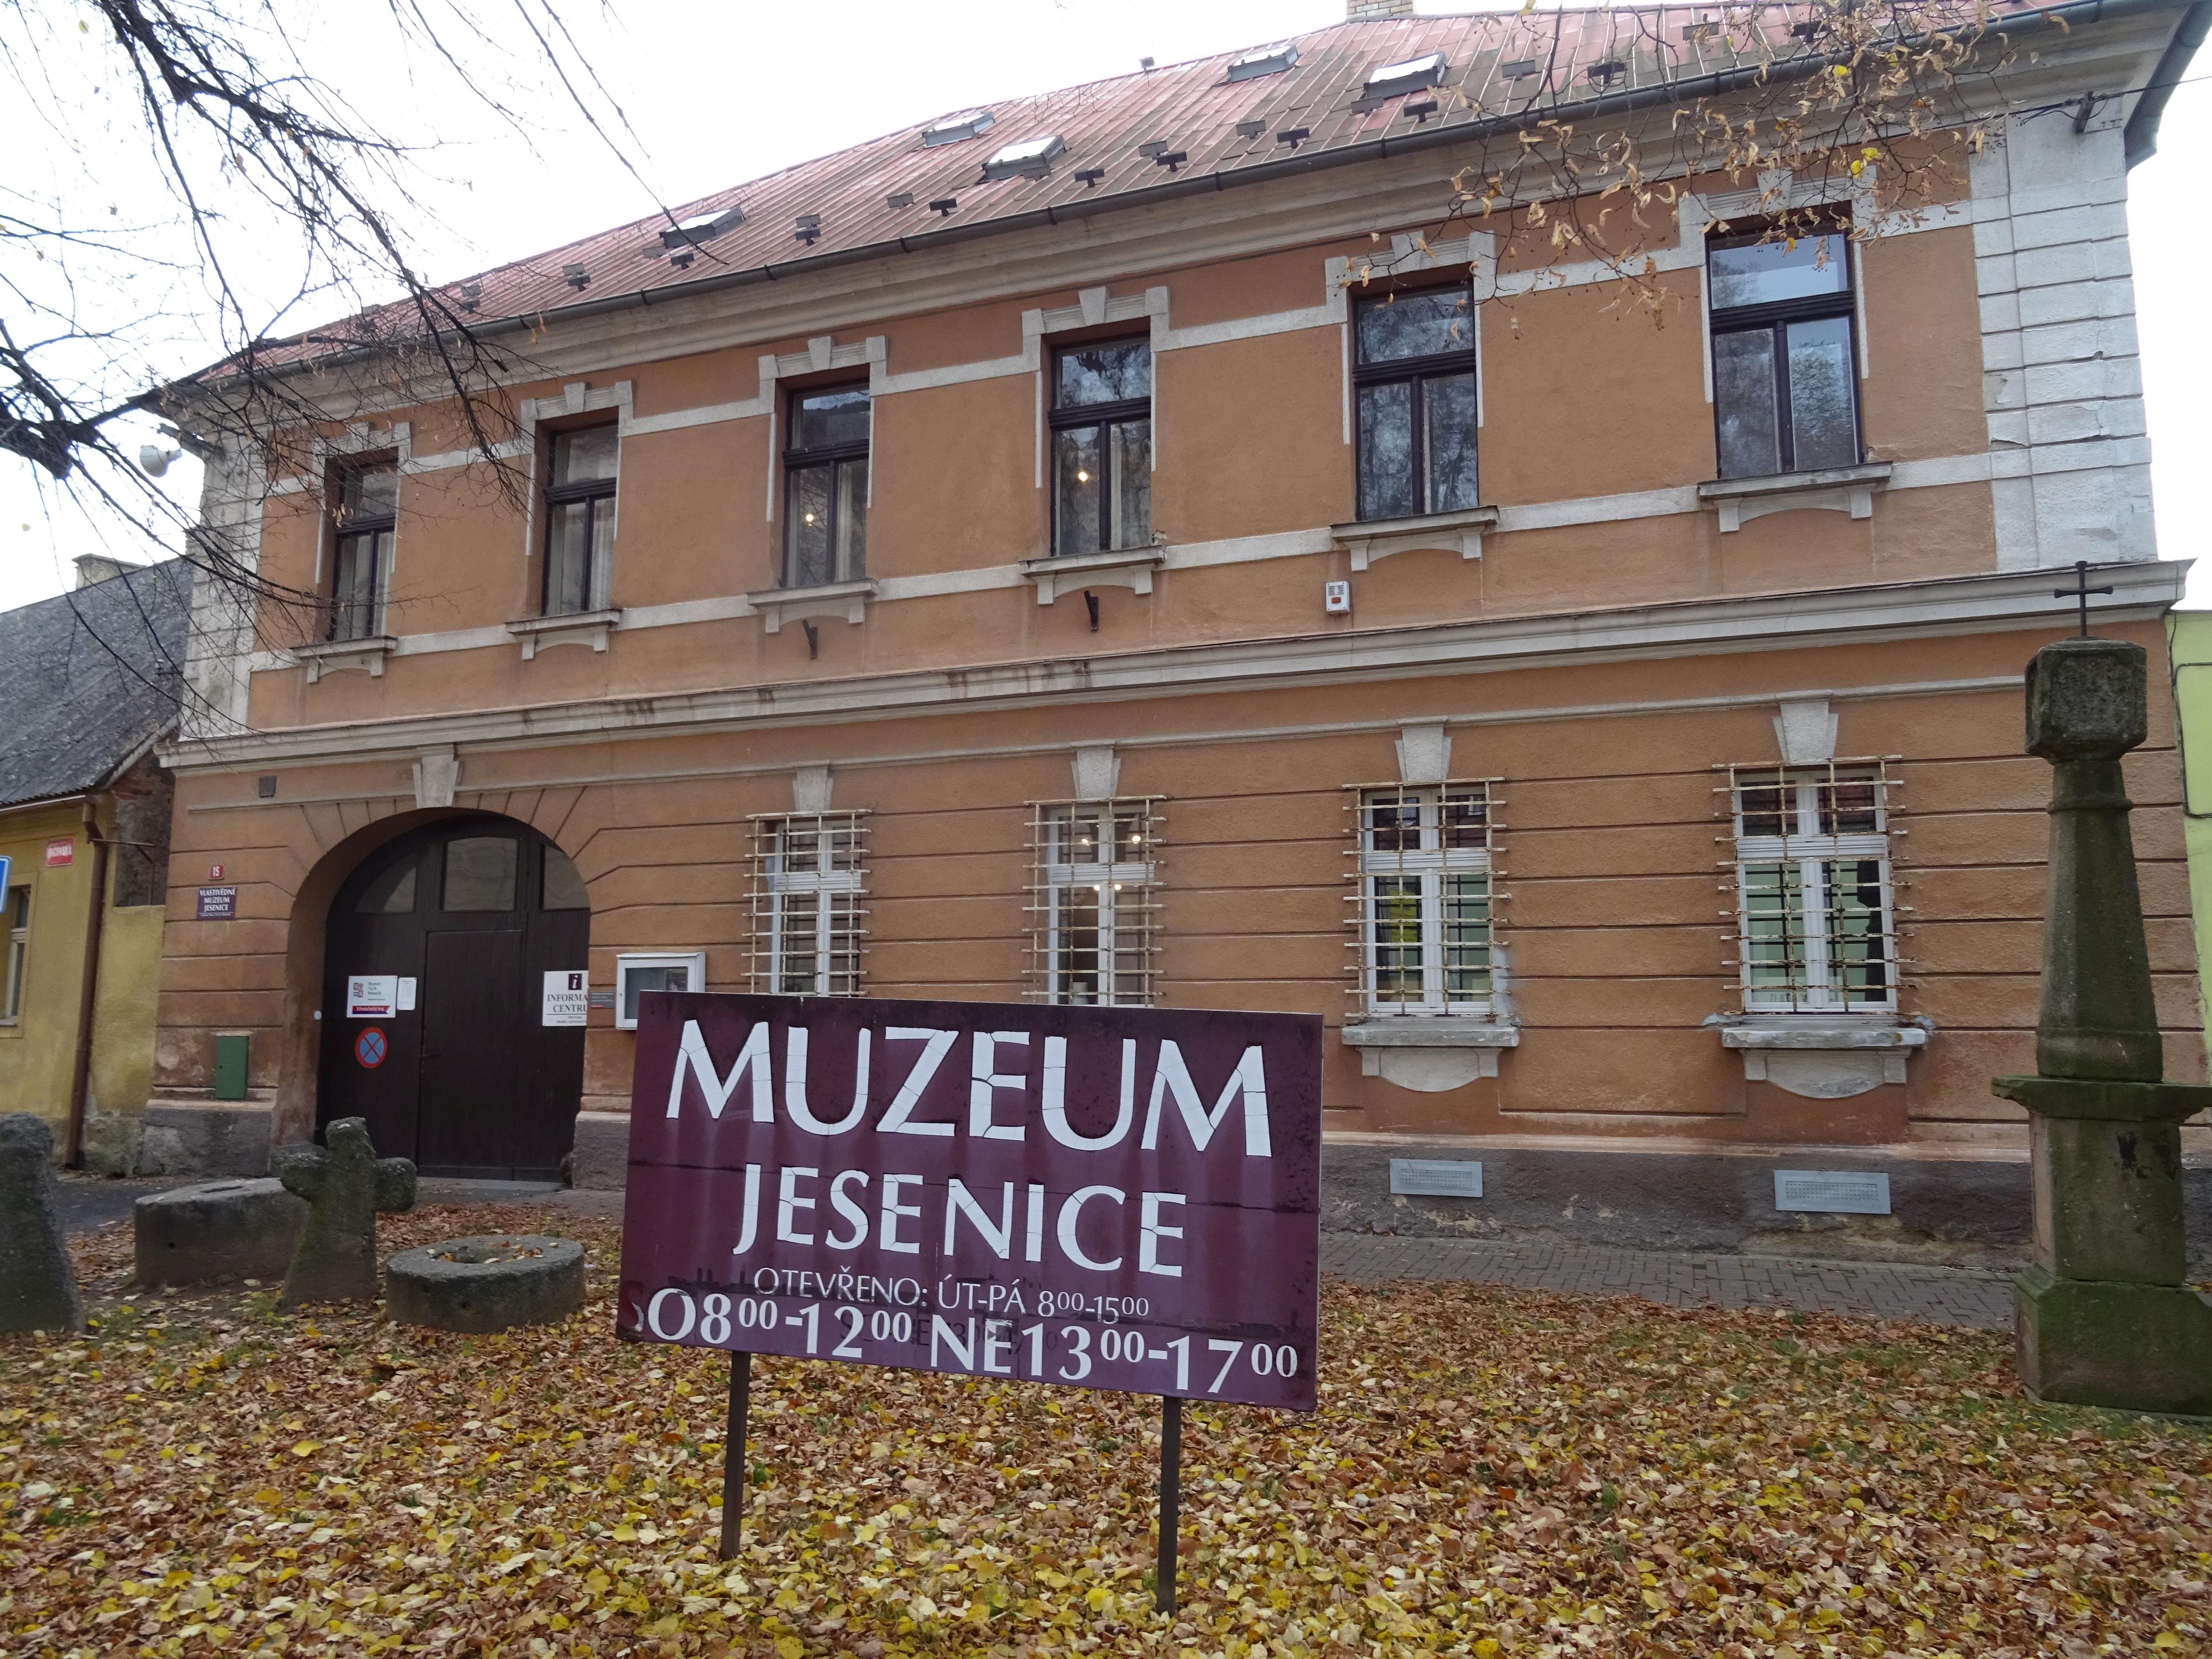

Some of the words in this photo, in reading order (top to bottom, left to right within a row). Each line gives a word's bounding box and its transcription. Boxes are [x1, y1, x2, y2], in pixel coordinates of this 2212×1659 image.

[212, 866, 220, 877] 15
[200, 886, 236, 896] VLASTIVĚDNÉ
[204, 904, 229, 912] JESENICE
[666, 1019, 1272, 1157] MUZEUM
[733, 1163, 1187, 1278] JESENICE
[754, 1265, 927, 1307] OTEVŘENO:
[938, 1274, 1027, 1314] ÚT-PÁ
